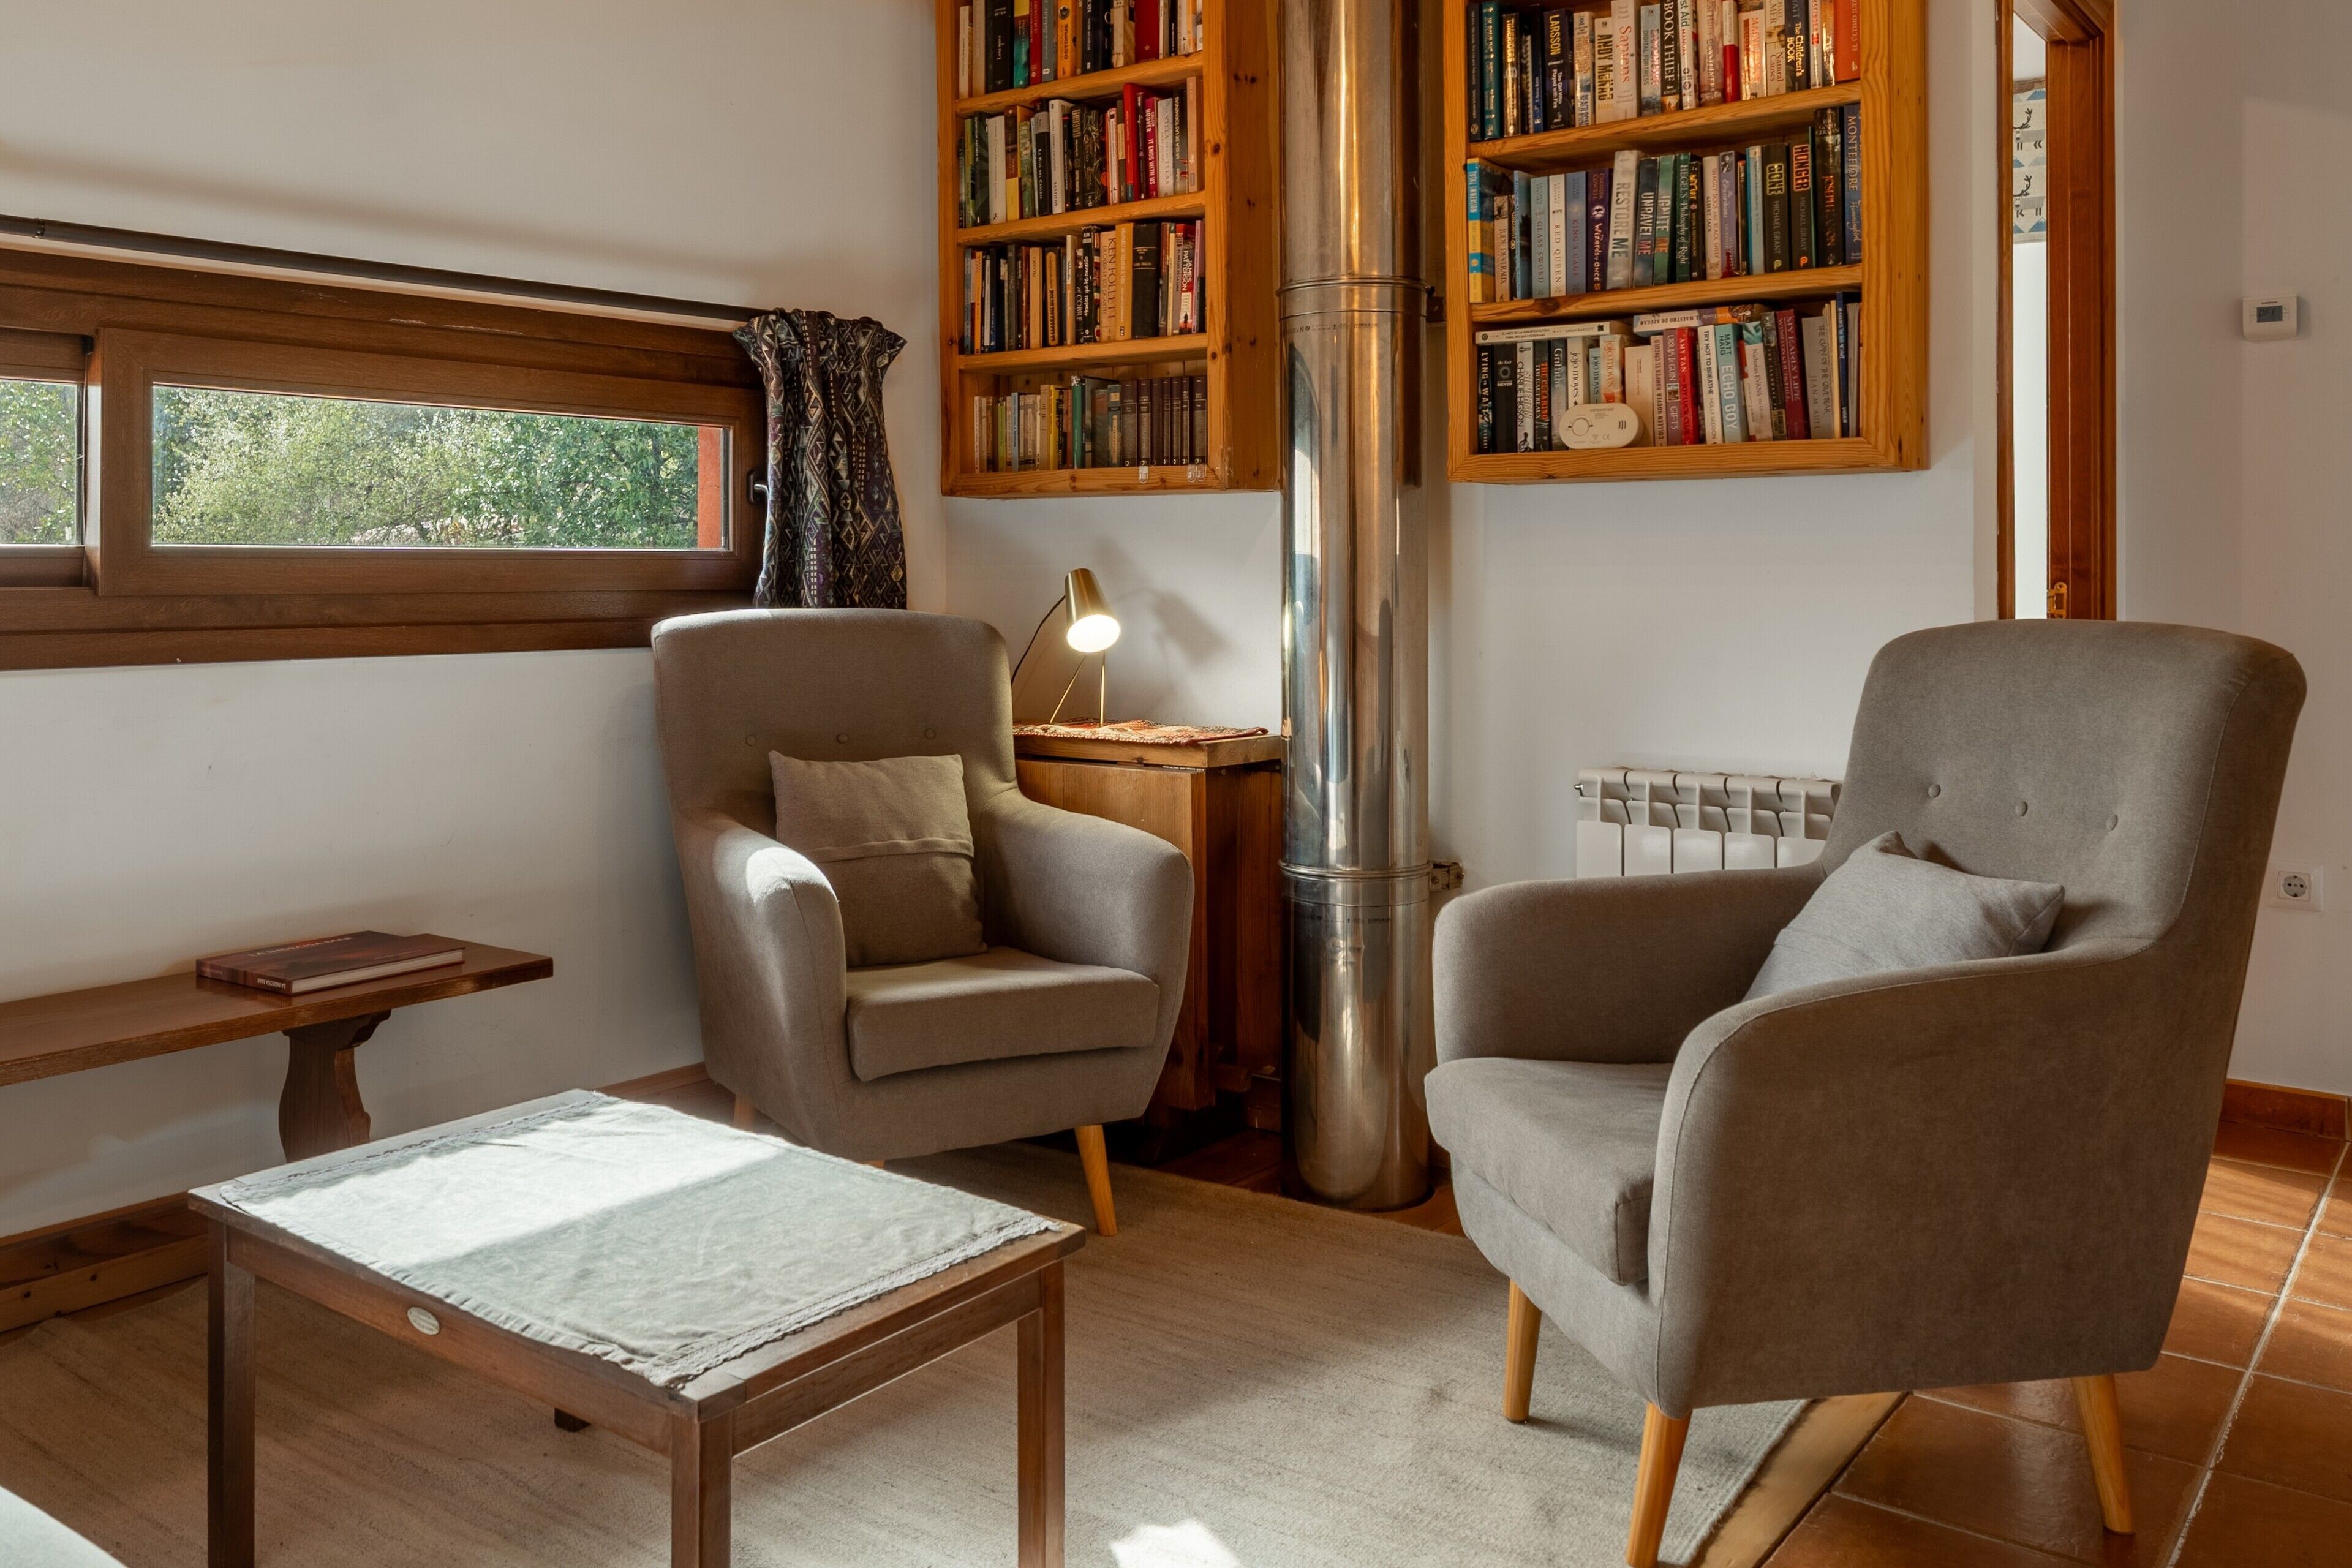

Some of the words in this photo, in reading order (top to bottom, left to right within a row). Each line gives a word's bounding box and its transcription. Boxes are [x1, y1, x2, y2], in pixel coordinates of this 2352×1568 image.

[1549, 14, 1561, 55] LARSSON
[1664, 2, 1674, 41] BOOK
[1681, 12, 1690, 27] Aid
[1597, 34, 1613, 61] ANDY
[1616, 26, 1632, 83] Sapiens
[1664, 42, 1675, 81] THIEF
[1795, 35, 1804, 77] Children's
[1597, 64, 1613, 101] McNAB
[1847, 116, 1858, 192] MONTEFIORE
[1766, 163, 1784, 195] GONE
[1822, 175, 1835, 207] JOSEPH
[1469, 186, 1478, 213] IMMERSION
[1613, 183, 1631, 235] RESTORE
[1639, 192, 1654, 237] UNRAVEL
[1656, 195, 1671, 232] IGNITE
[1677, 202, 1689, 236] Philosophy
[1847, 202, 1861, 243] Hummingbird
[1611, 238, 1629, 258] ME
[1638, 240, 1651, 255] ME
[1655, 237, 1670, 254] ME
[1678, 246, 1689, 264] Right
[1786, 316, 1793, 333] MY
[1570, 352, 1580, 369] jojo
[1592, 355, 1600, 371] jojo
[1604, 341, 1615, 357] jojo
[1706, 357, 1711, 366] TO
[1752, 349, 1761, 374] Nicholas
[1788, 336, 1798, 372] EARLY
[1553, 347, 1563, 388] Griffiths
[1605, 358, 1615, 388] moyes
[1721, 365, 1735, 399] ECHO
[1571, 370, 1580, 398] moyes
[1725, 404, 1737, 429] BOY
[1812, 398, 1819, 407] M.
